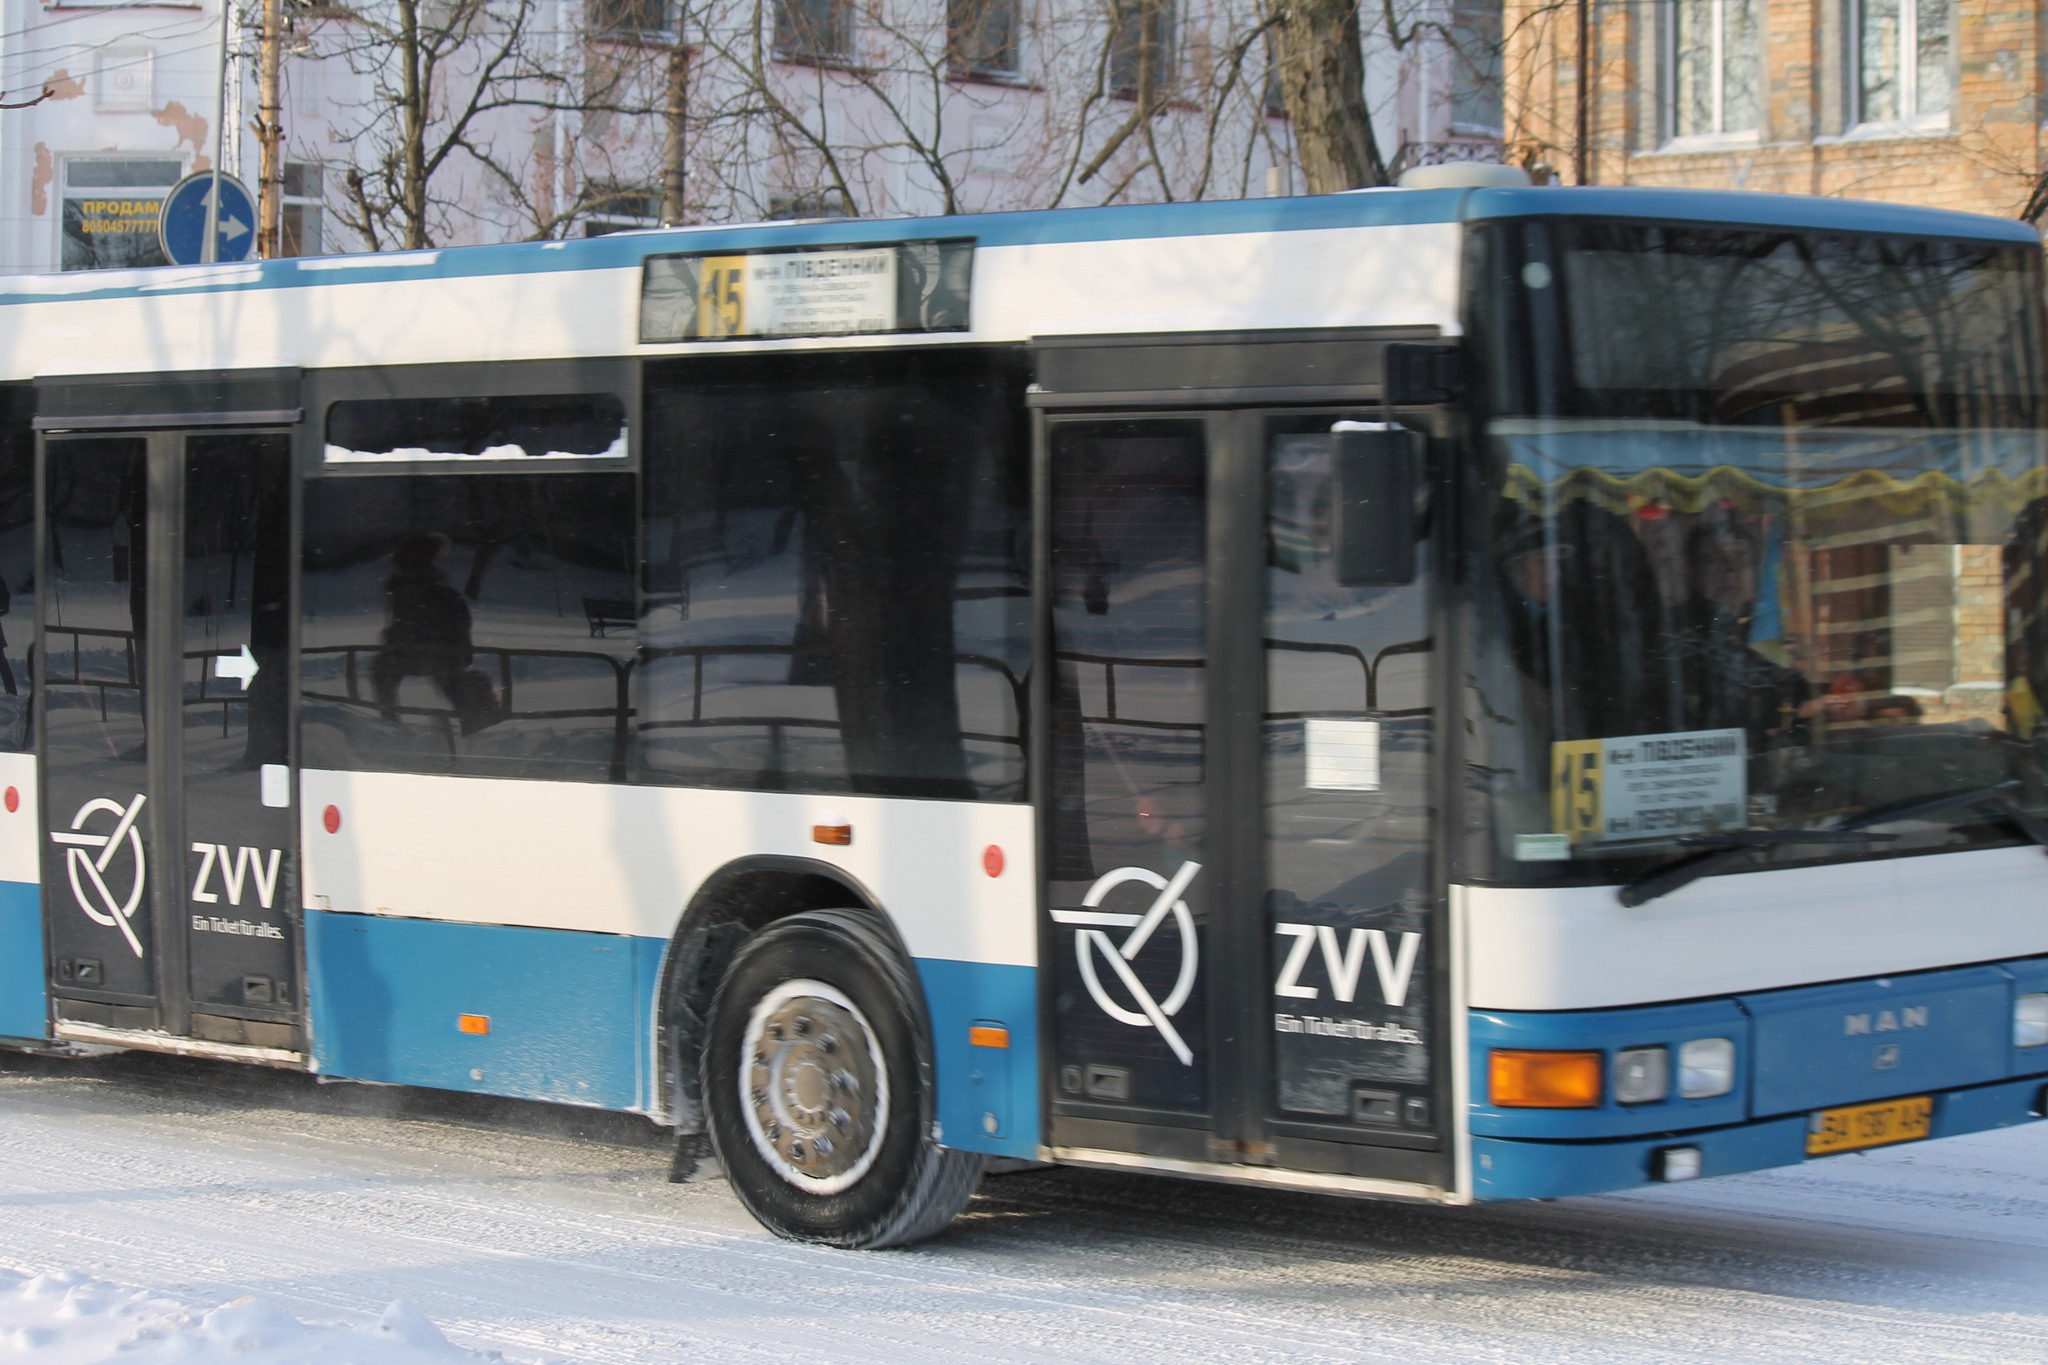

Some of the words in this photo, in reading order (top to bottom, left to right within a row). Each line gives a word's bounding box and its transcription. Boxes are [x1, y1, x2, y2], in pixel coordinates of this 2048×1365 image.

[83, 202, 159, 216] ПРОДАМ
[82, 220, 158, 233] 80504577777
[705, 267, 743, 335] 15
[1556, 752, 1598, 830] 15
[208, 916, 240, 935] Ticket
[1844, 1006, 1929, 1036] MAN
